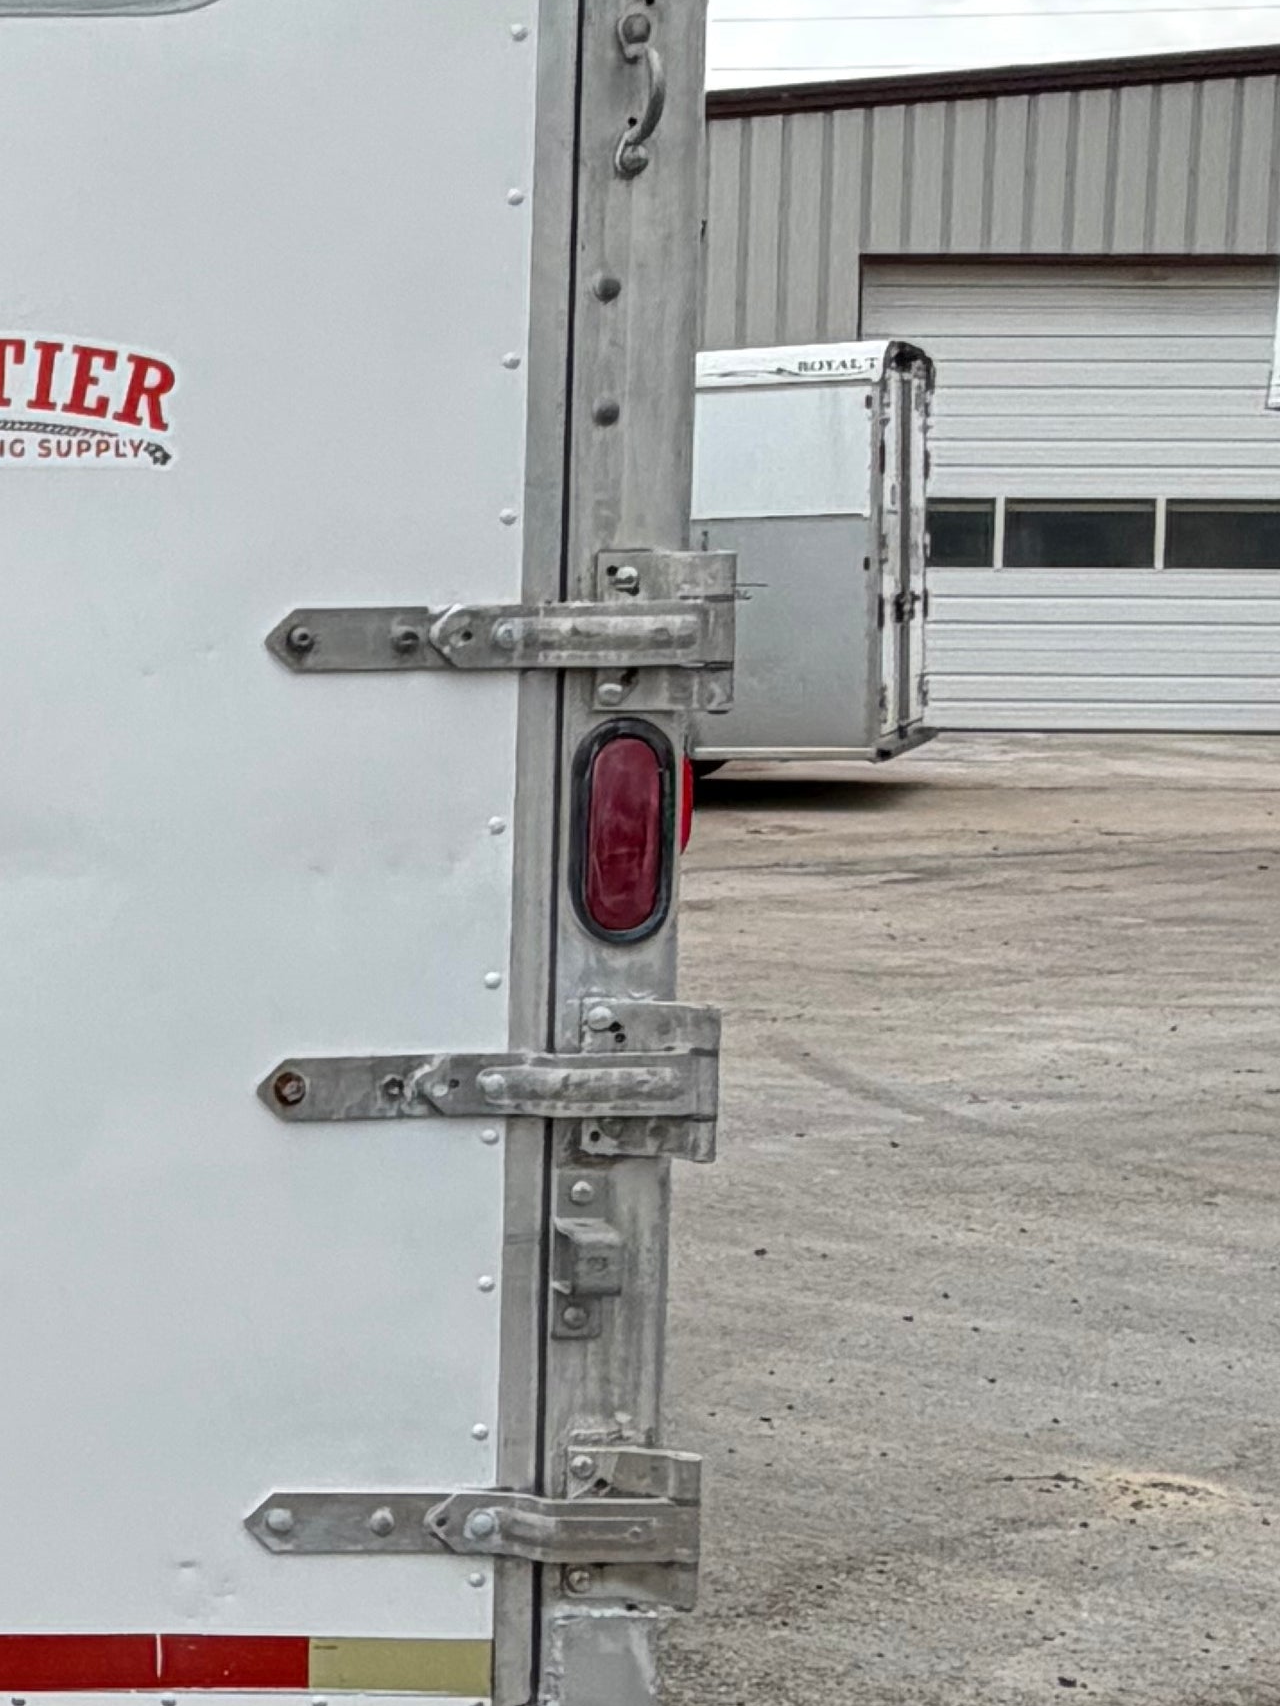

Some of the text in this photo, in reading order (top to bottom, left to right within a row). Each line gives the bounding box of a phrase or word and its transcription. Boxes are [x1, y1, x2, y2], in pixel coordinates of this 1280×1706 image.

[798, 357, 878, 372] ROYAL T
[38, 437, 142, 459] SUPPLY
